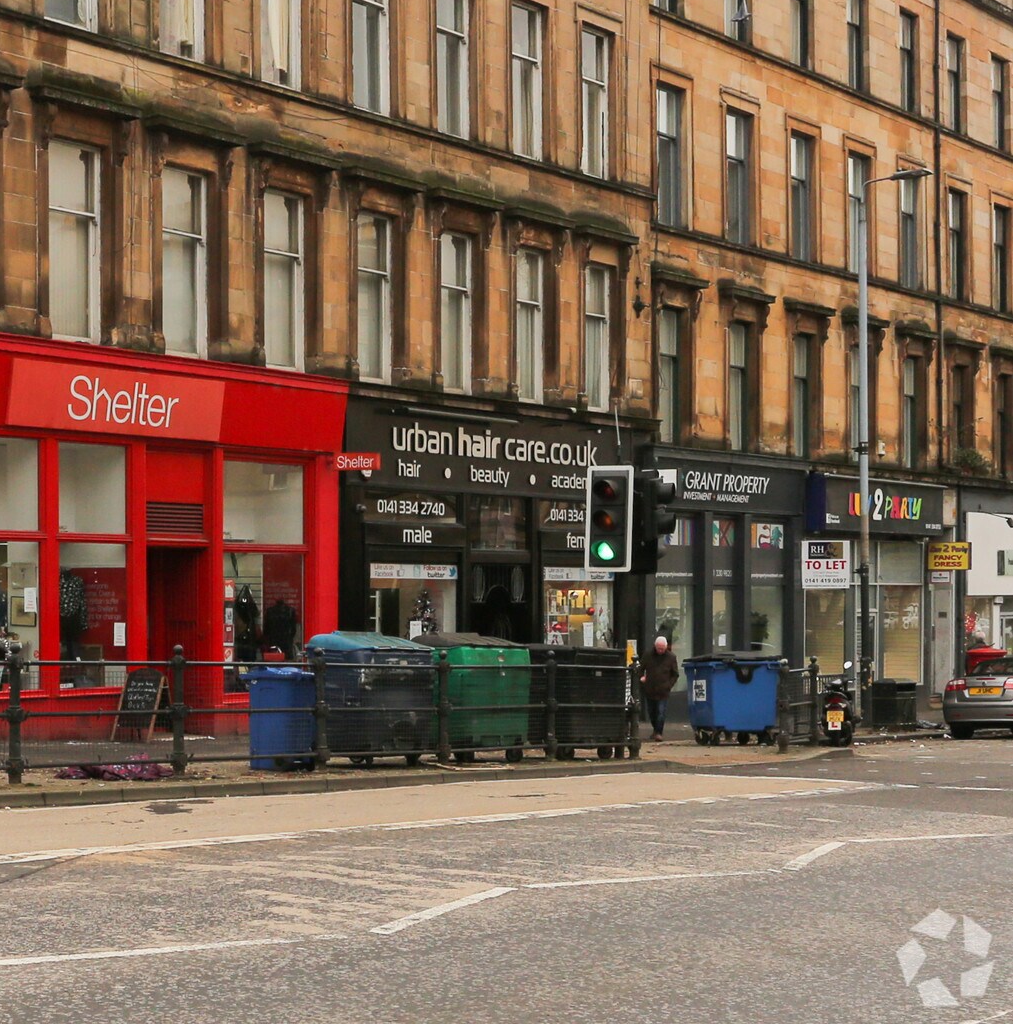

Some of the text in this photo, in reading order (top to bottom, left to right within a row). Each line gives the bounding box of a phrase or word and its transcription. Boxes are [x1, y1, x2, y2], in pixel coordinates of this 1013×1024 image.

[68, 375, 179, 428] Shelter
[393, 422, 598, 467] urban hair care.co.uk
[337, 455, 374, 468] Shelter
[398, 459, 421, 478] hair
[470, 465, 510, 488] beauty
[685, 470, 770, 494] GRANT PROPERTY
[683, 491, 750, 503] INVESTMENT MANAGEMENT
[873, 488, 884, 520] 2
[884, 495, 923, 520] PARTY
[377, 499, 445, 516] 0141 334 2740
[550, 508, 584, 522] 0141 334
[403, 526, 432, 544] male
[810, 545, 824, 553] RH
[943, 544, 949, 552] 2
[805, 560, 847, 570] TO LET
